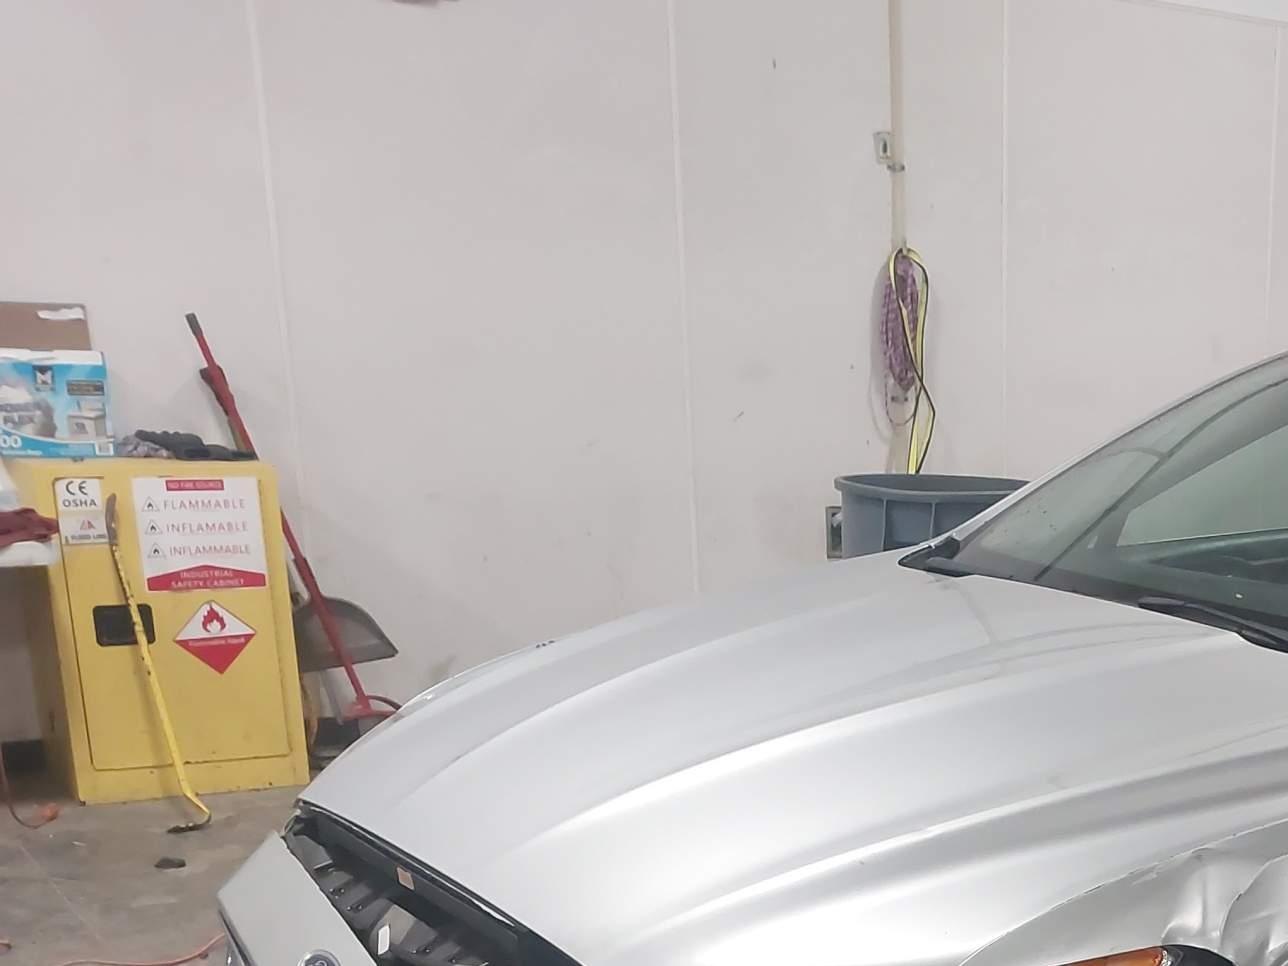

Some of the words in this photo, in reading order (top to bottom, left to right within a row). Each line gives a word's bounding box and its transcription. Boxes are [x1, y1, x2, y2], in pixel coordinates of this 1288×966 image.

[65, 480, 88, 496] CE
[62, 499, 97, 508] OSHA
[163, 498, 247, 511] FLAMMABLE
[166, 520, 249, 533] INFLAMABLE
[169, 543, 251, 556] INFLAMMABLE
[180, 569, 233, 579] INDUSTRIAL
[171, 579, 204, 589] SAFETY
[206, 578, 245, 588] CABINET
